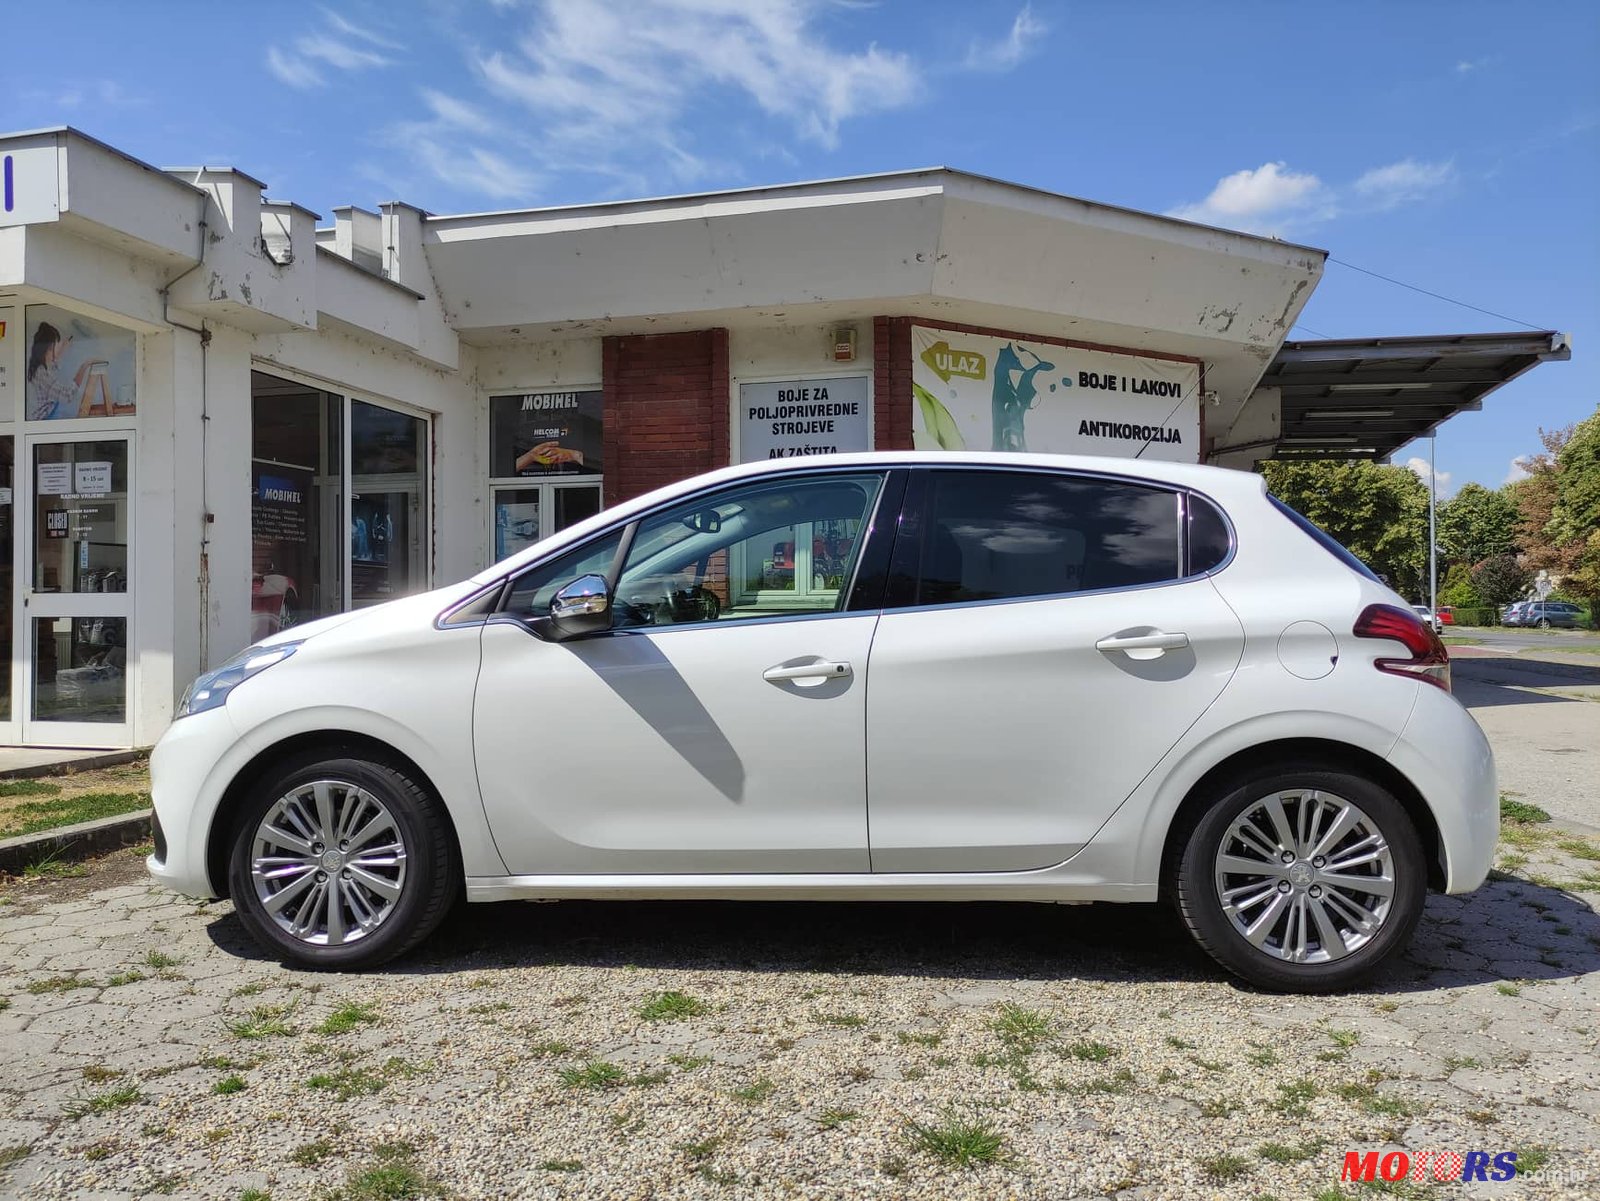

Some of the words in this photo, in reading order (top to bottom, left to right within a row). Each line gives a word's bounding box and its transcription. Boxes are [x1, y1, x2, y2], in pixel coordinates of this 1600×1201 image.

[935, 353, 980, 374] ULAZ
[1079, 371, 1117, 391] BOJE
[1122, 377, 1127, 392] I
[1131, 378, 1181, 398] LAKOVI
[521, 393, 578, 411] MOBIHEL
[778, 389, 809, 402] BOJE
[813, 387, 829, 400] ZA
[749, 402, 859, 420] POLJOPRIVREDNE
[772, 420, 834, 435] STROJEVE
[1078, 420, 1182, 444] ANTIKOROZIJA
[264, 487, 302, 503] MOBIHEL
[47, 512, 68, 530] CLOSED
